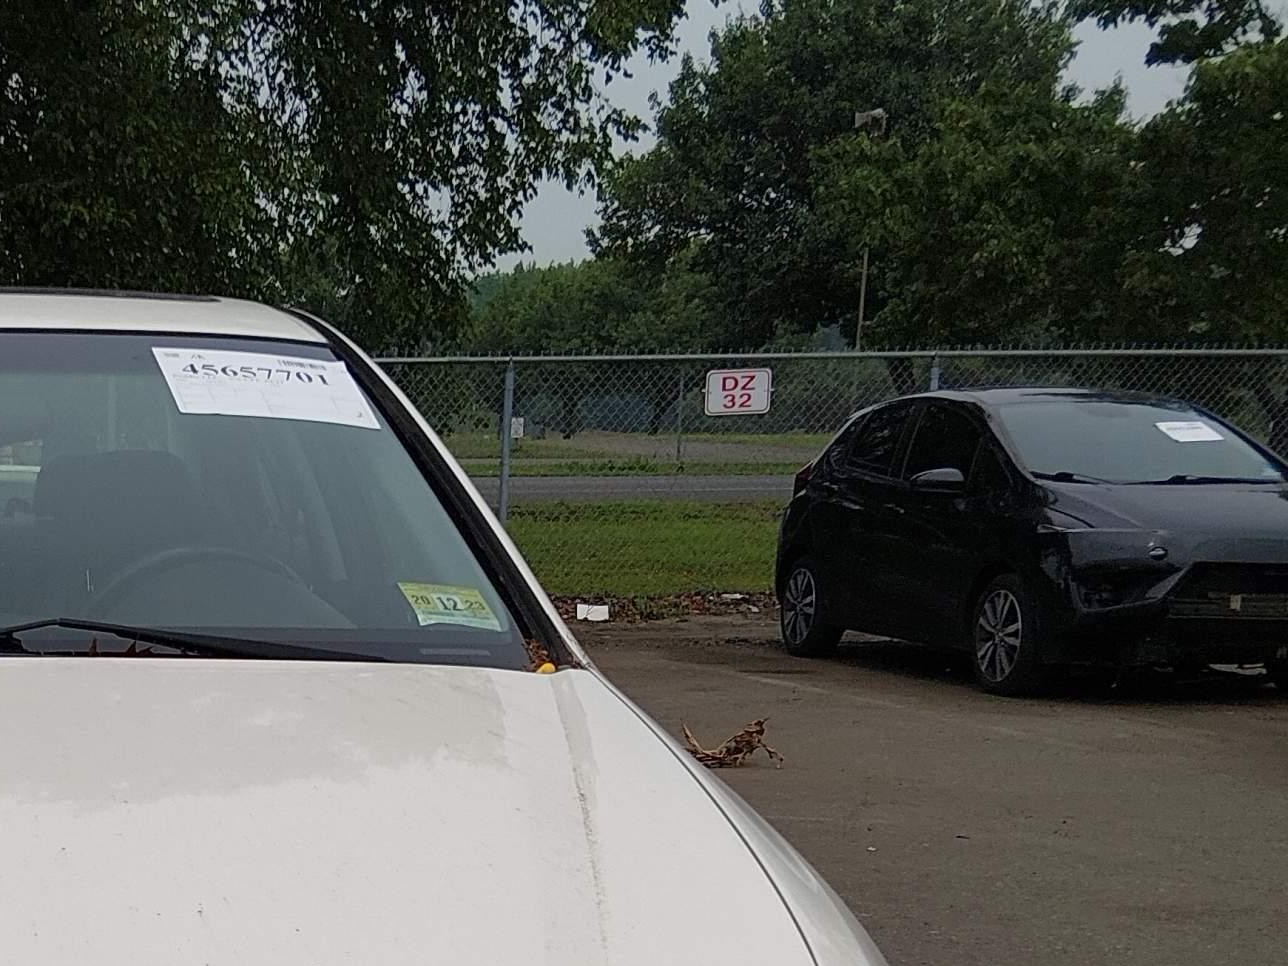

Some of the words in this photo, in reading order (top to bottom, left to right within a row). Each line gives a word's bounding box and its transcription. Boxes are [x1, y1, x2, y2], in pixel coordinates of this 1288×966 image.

[182, 363, 329, 386] 45657701
[721, 375, 756, 392] DZ
[722, 393, 752, 409] 32
[437, 596, 462, 612] 12
